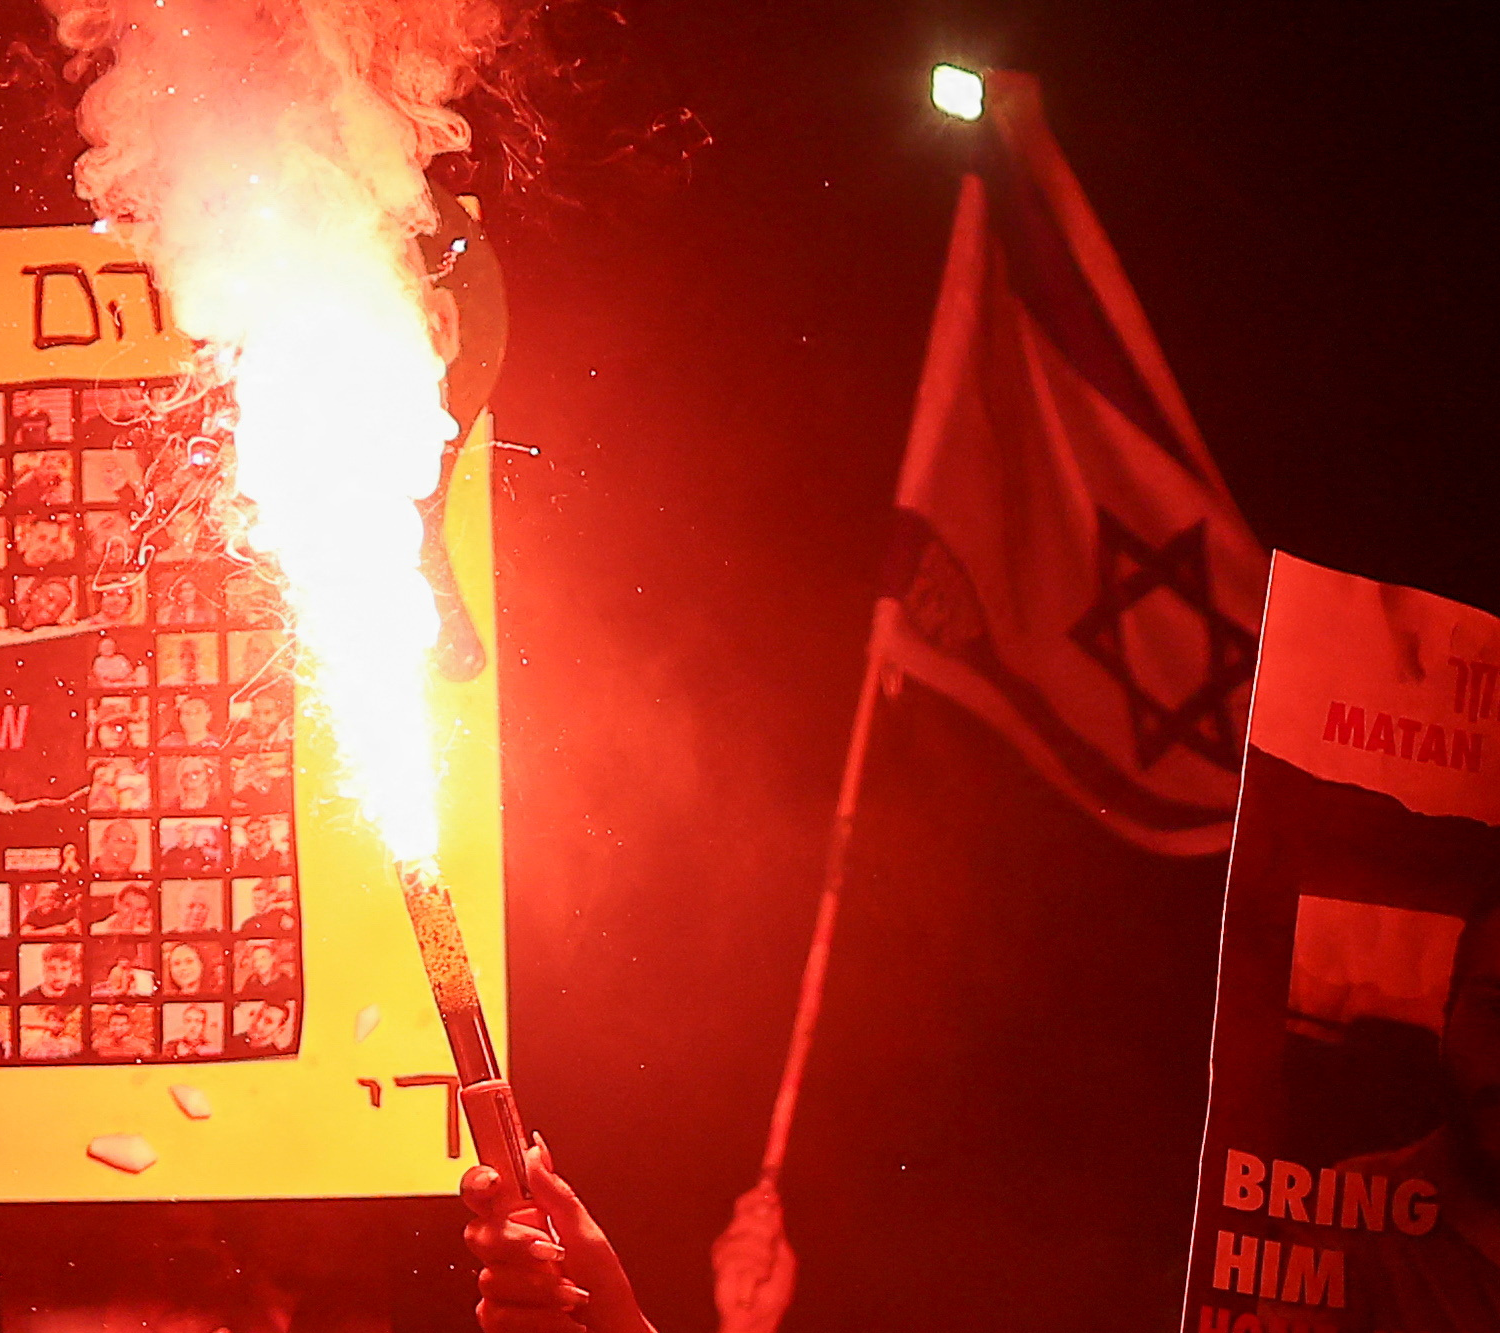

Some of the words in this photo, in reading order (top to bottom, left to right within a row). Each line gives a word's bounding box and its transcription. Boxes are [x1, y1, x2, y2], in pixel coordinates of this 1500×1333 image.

[21, 262, 164, 350] הם
[1322, 701, 1484, 773] MATAN
[1222, 1147, 1440, 1238] BRING
[1211, 1228, 1347, 1310] HIM
